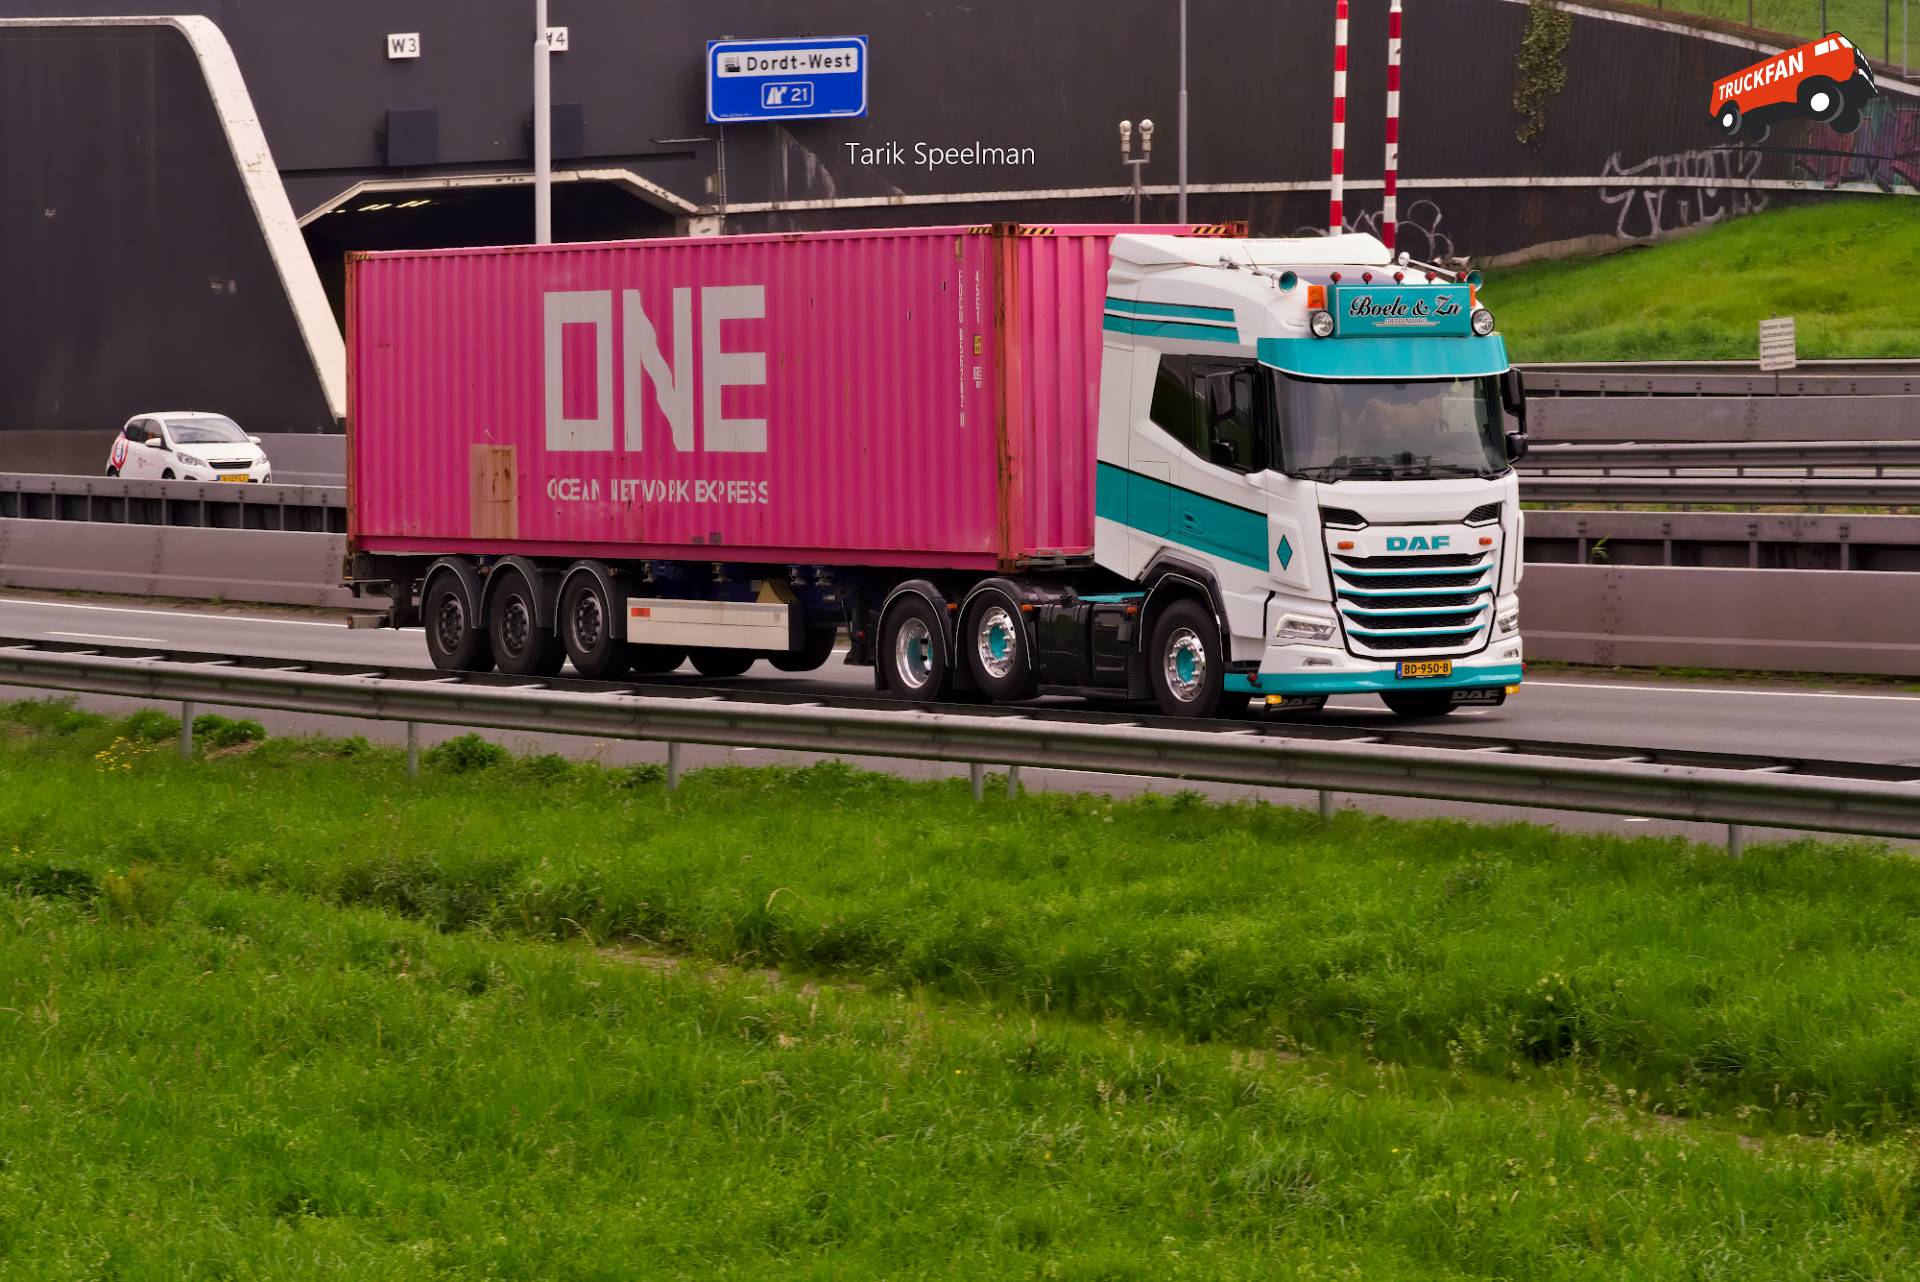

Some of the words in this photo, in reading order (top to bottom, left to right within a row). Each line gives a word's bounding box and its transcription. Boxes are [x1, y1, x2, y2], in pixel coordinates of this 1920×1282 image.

[747, 53, 852, 71] Dordt-West
[791, 87, 808, 102] 21
[1349, 295, 1408, 317] Boele
[1411, 299, 1431, 316] &
[1432, 294, 1462, 316] Zn
[544, 284, 767, 453] ONE
[547, 478, 600, 501] OCEAN
[695, 480, 768, 504] EXPRESS
[1386, 535, 1450, 551] DAF
[1451, 690, 1500, 700] DAF
